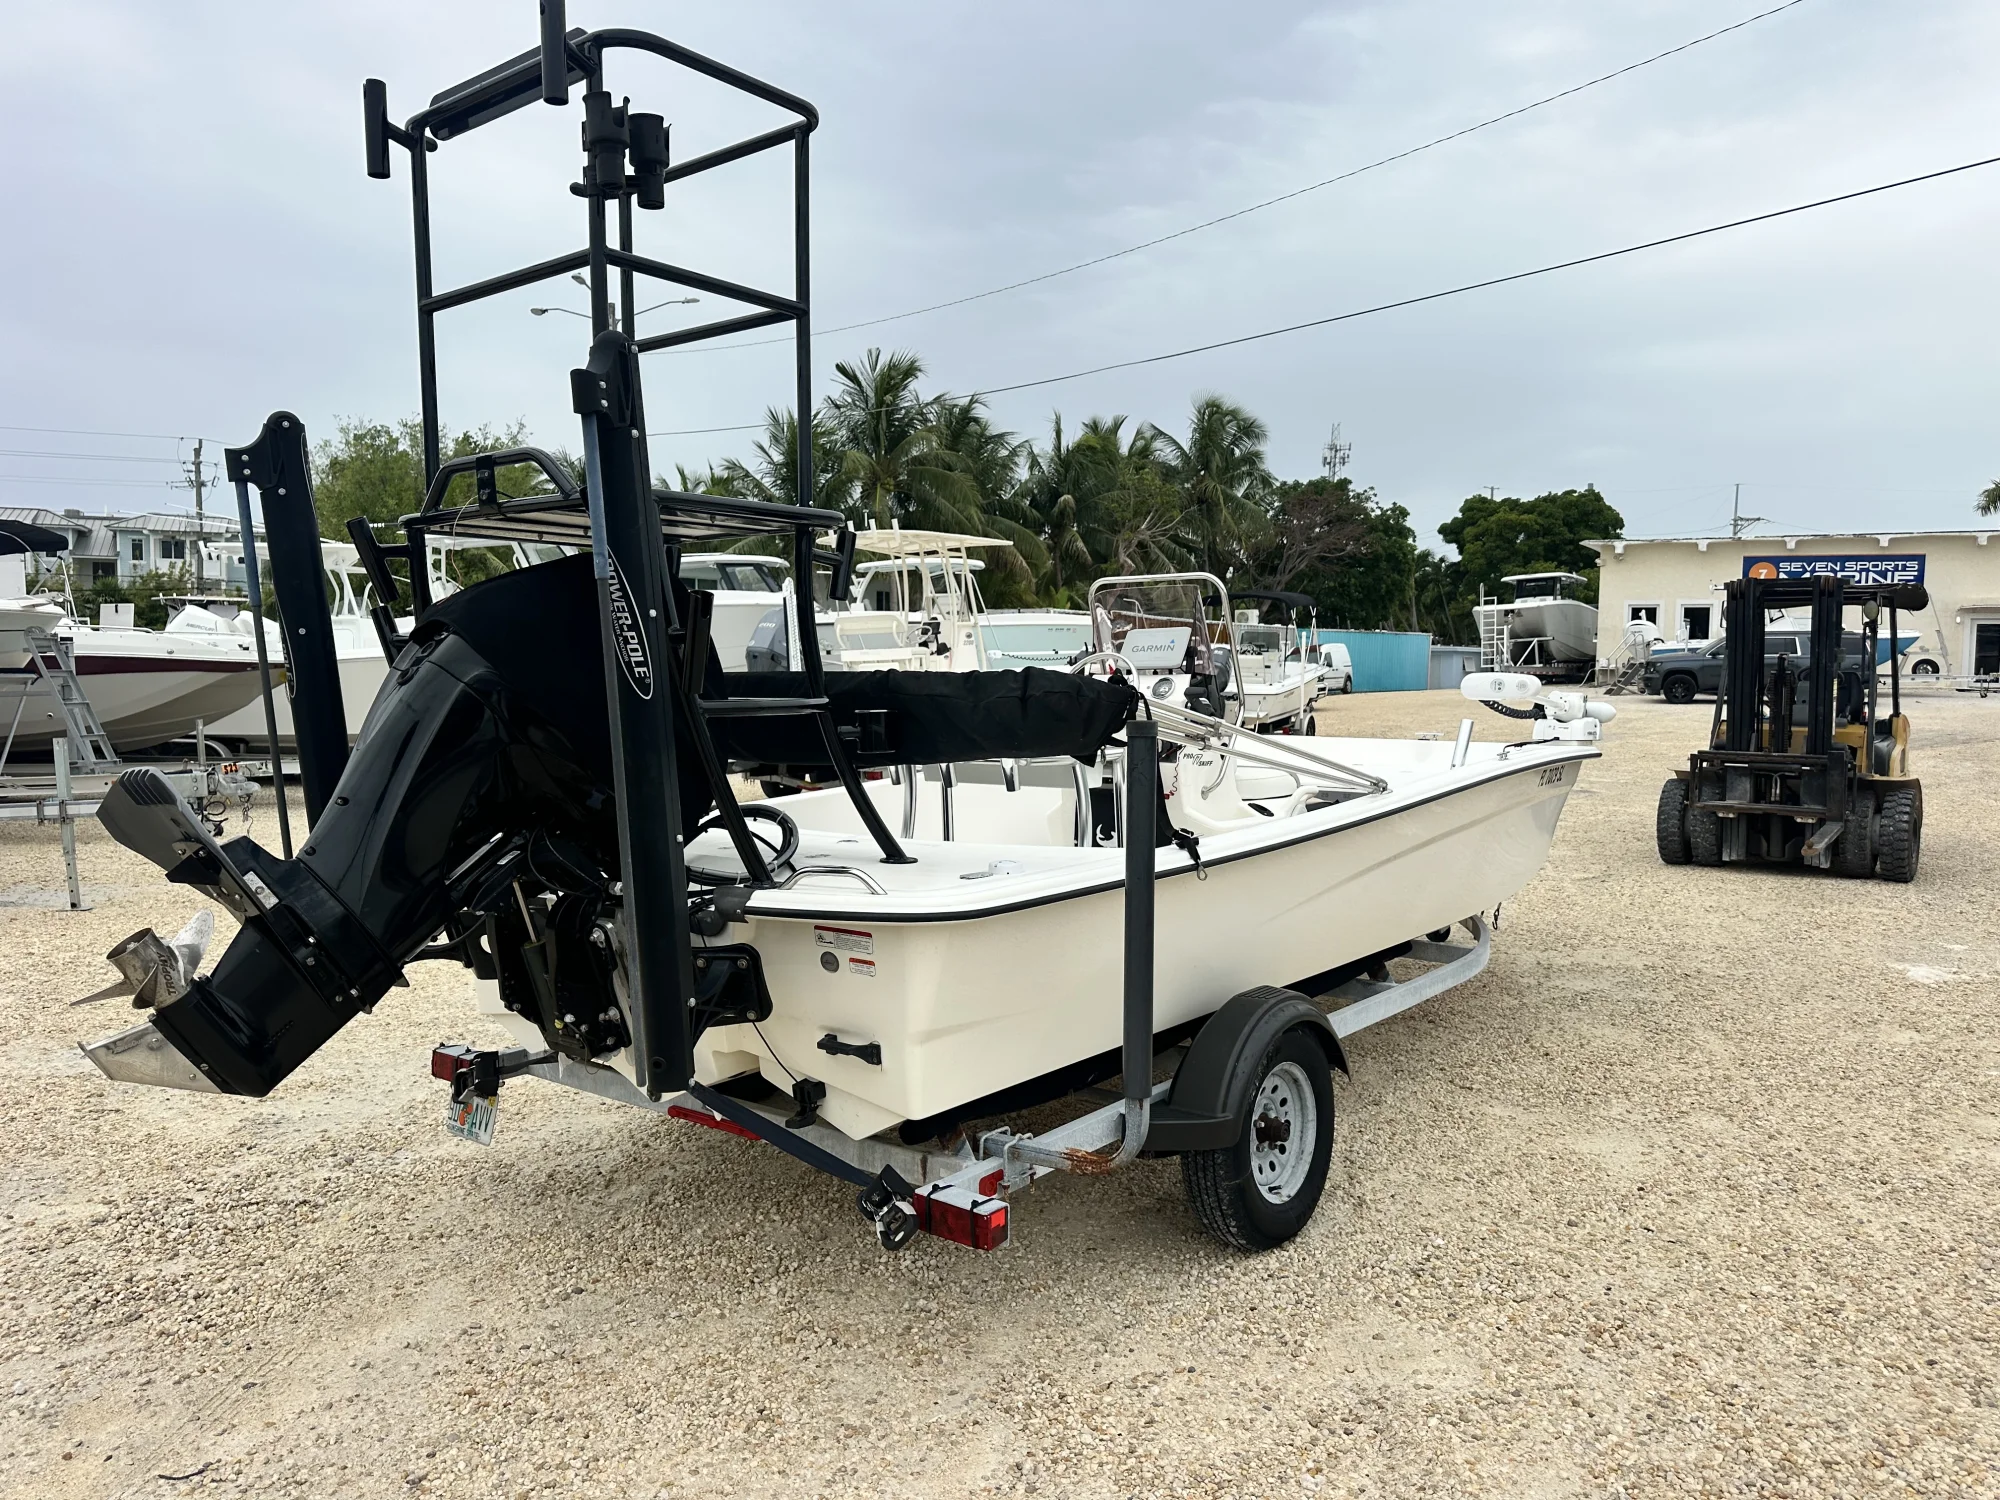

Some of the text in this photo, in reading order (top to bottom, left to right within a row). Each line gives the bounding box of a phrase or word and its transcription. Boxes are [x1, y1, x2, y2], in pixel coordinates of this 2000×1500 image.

[1779, 561, 1919, 572] SEVEN SPORTS
[1778, 571, 1918, 585] RINE
[1131, 644, 1175, 653] GARMIN
[157, 951, 177, 996] TROPHY
